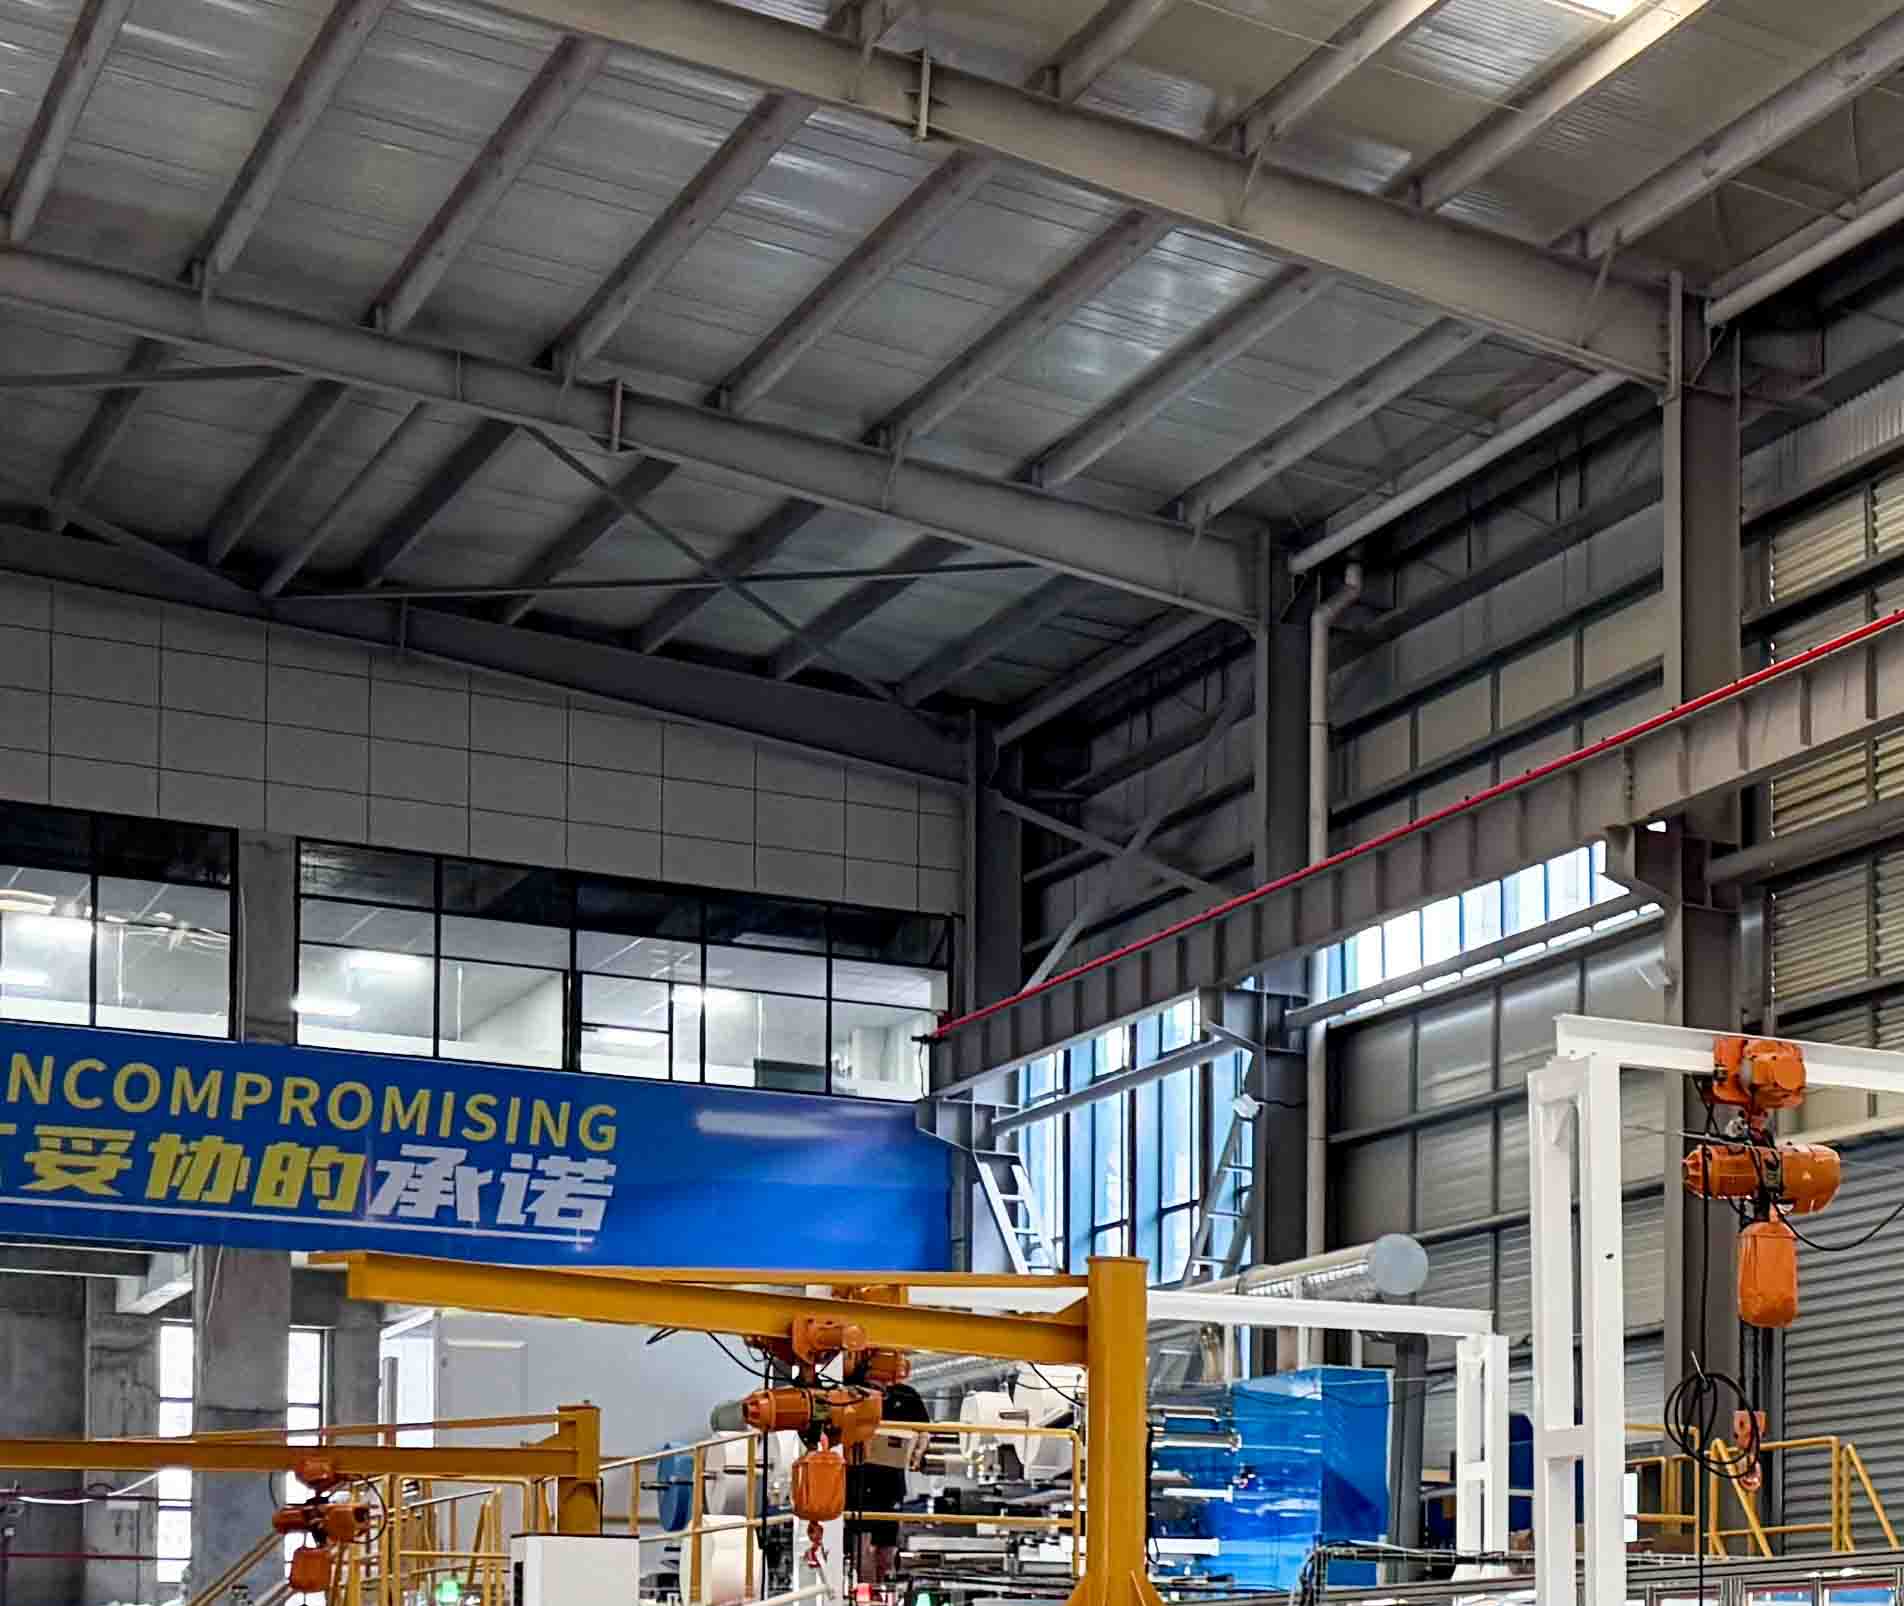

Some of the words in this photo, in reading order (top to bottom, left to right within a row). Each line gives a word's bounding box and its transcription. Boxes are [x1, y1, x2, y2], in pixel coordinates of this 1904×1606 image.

[7, 1052, 617, 1151] NCOMPROMISING
[0, 1122, 616, 1231] 妥协的承诺
